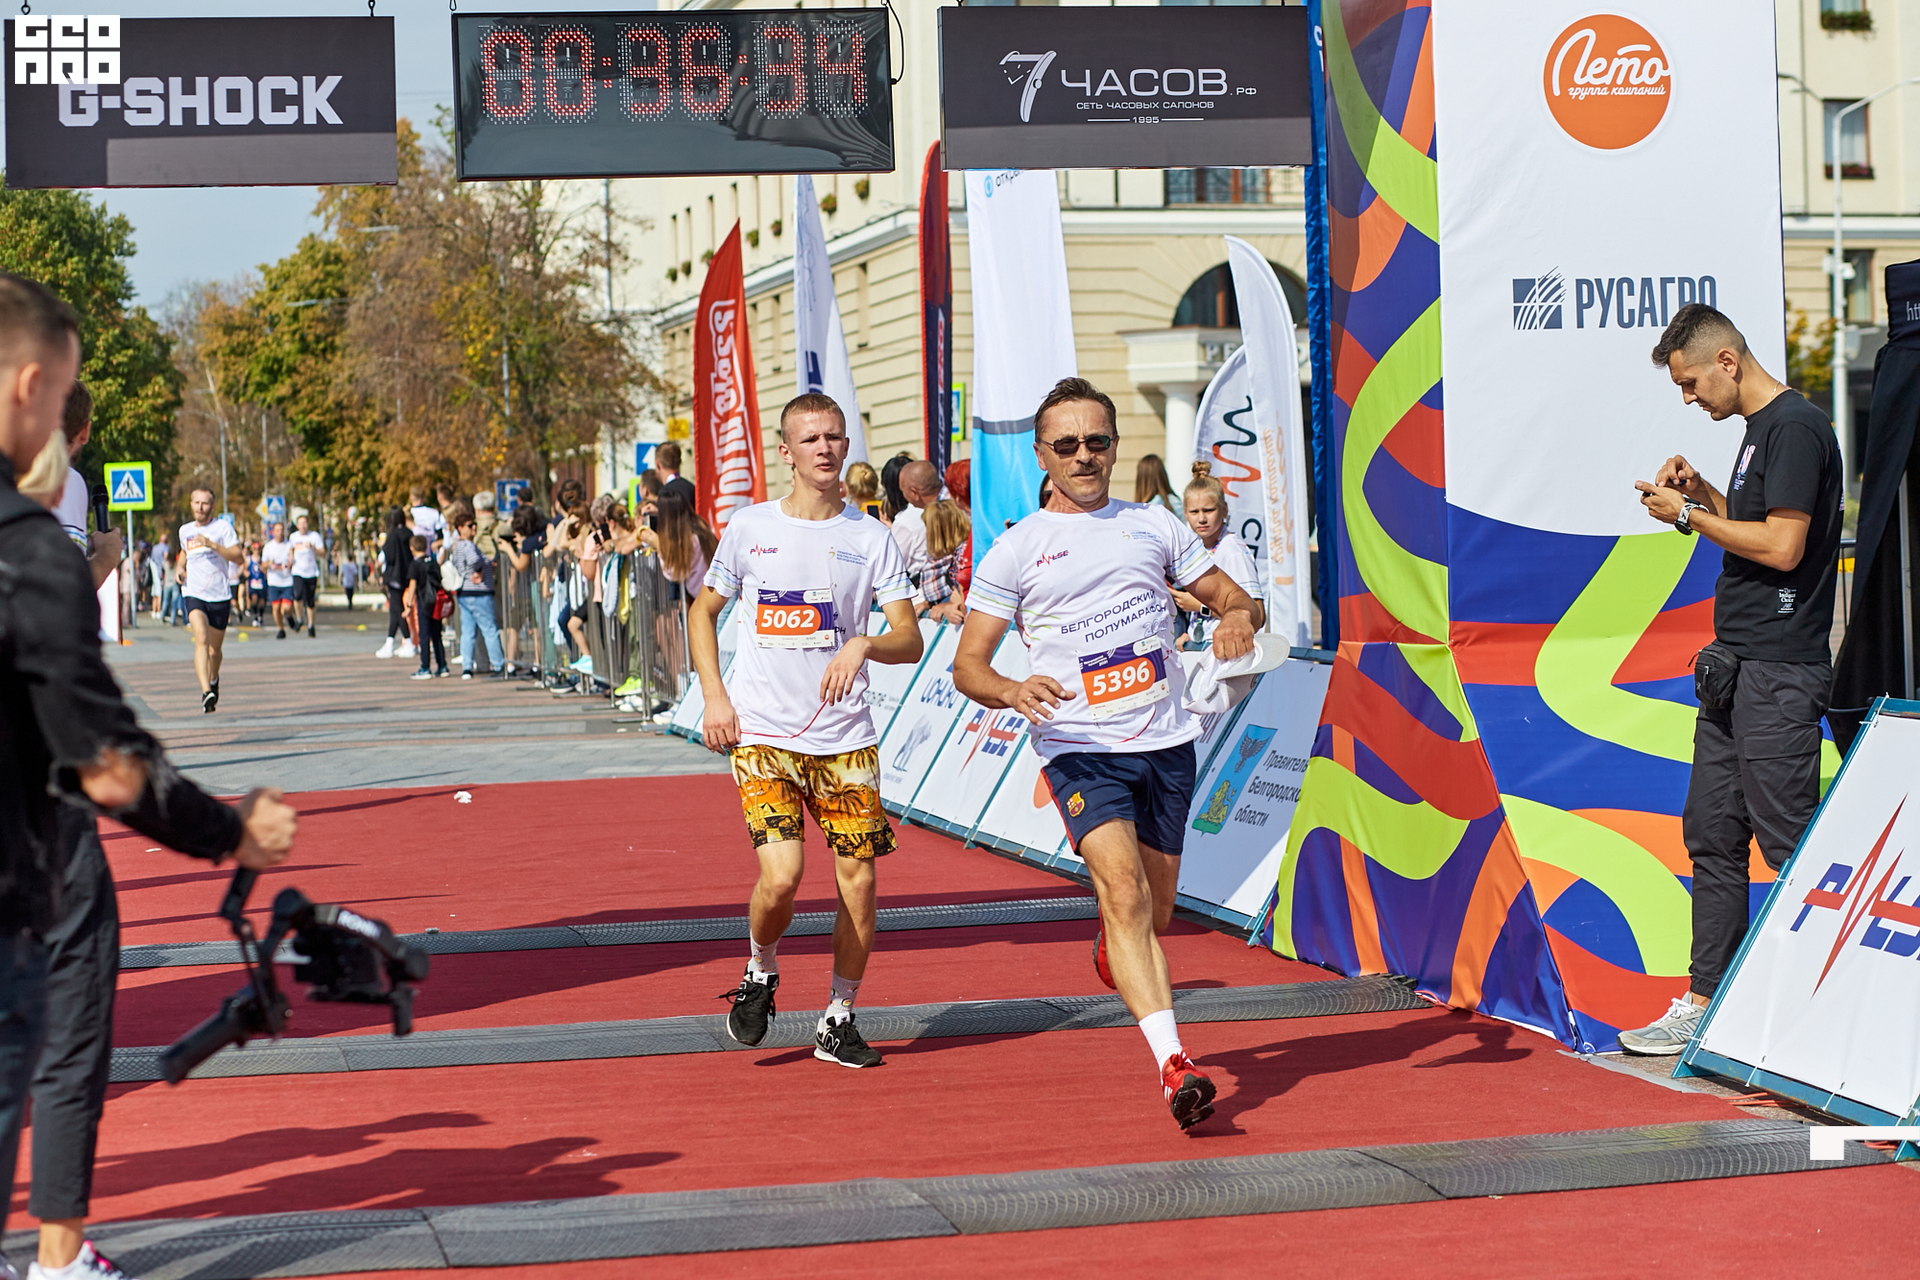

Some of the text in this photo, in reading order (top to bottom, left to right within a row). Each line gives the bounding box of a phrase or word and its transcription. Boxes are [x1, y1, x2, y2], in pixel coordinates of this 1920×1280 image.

[58, 75, 344, 127] G-SHOCK
[1076, 101, 1215, 110] СЕТЬ ЧАСОВЫХ САЛОНОВ
[1132, 116, 1160, 124] 1995
[1575, 275, 1717, 329] РУСАГРО
[761, 609, 815, 628] 5062
[1061, 589, 1156, 634] БЕЛГОРОДСКИЙ
[1085, 603, 1167, 642] ПОЛУМАРАФОН
[1092, 660, 1150, 696] 5396
[1234, 804, 1269, 827] области
